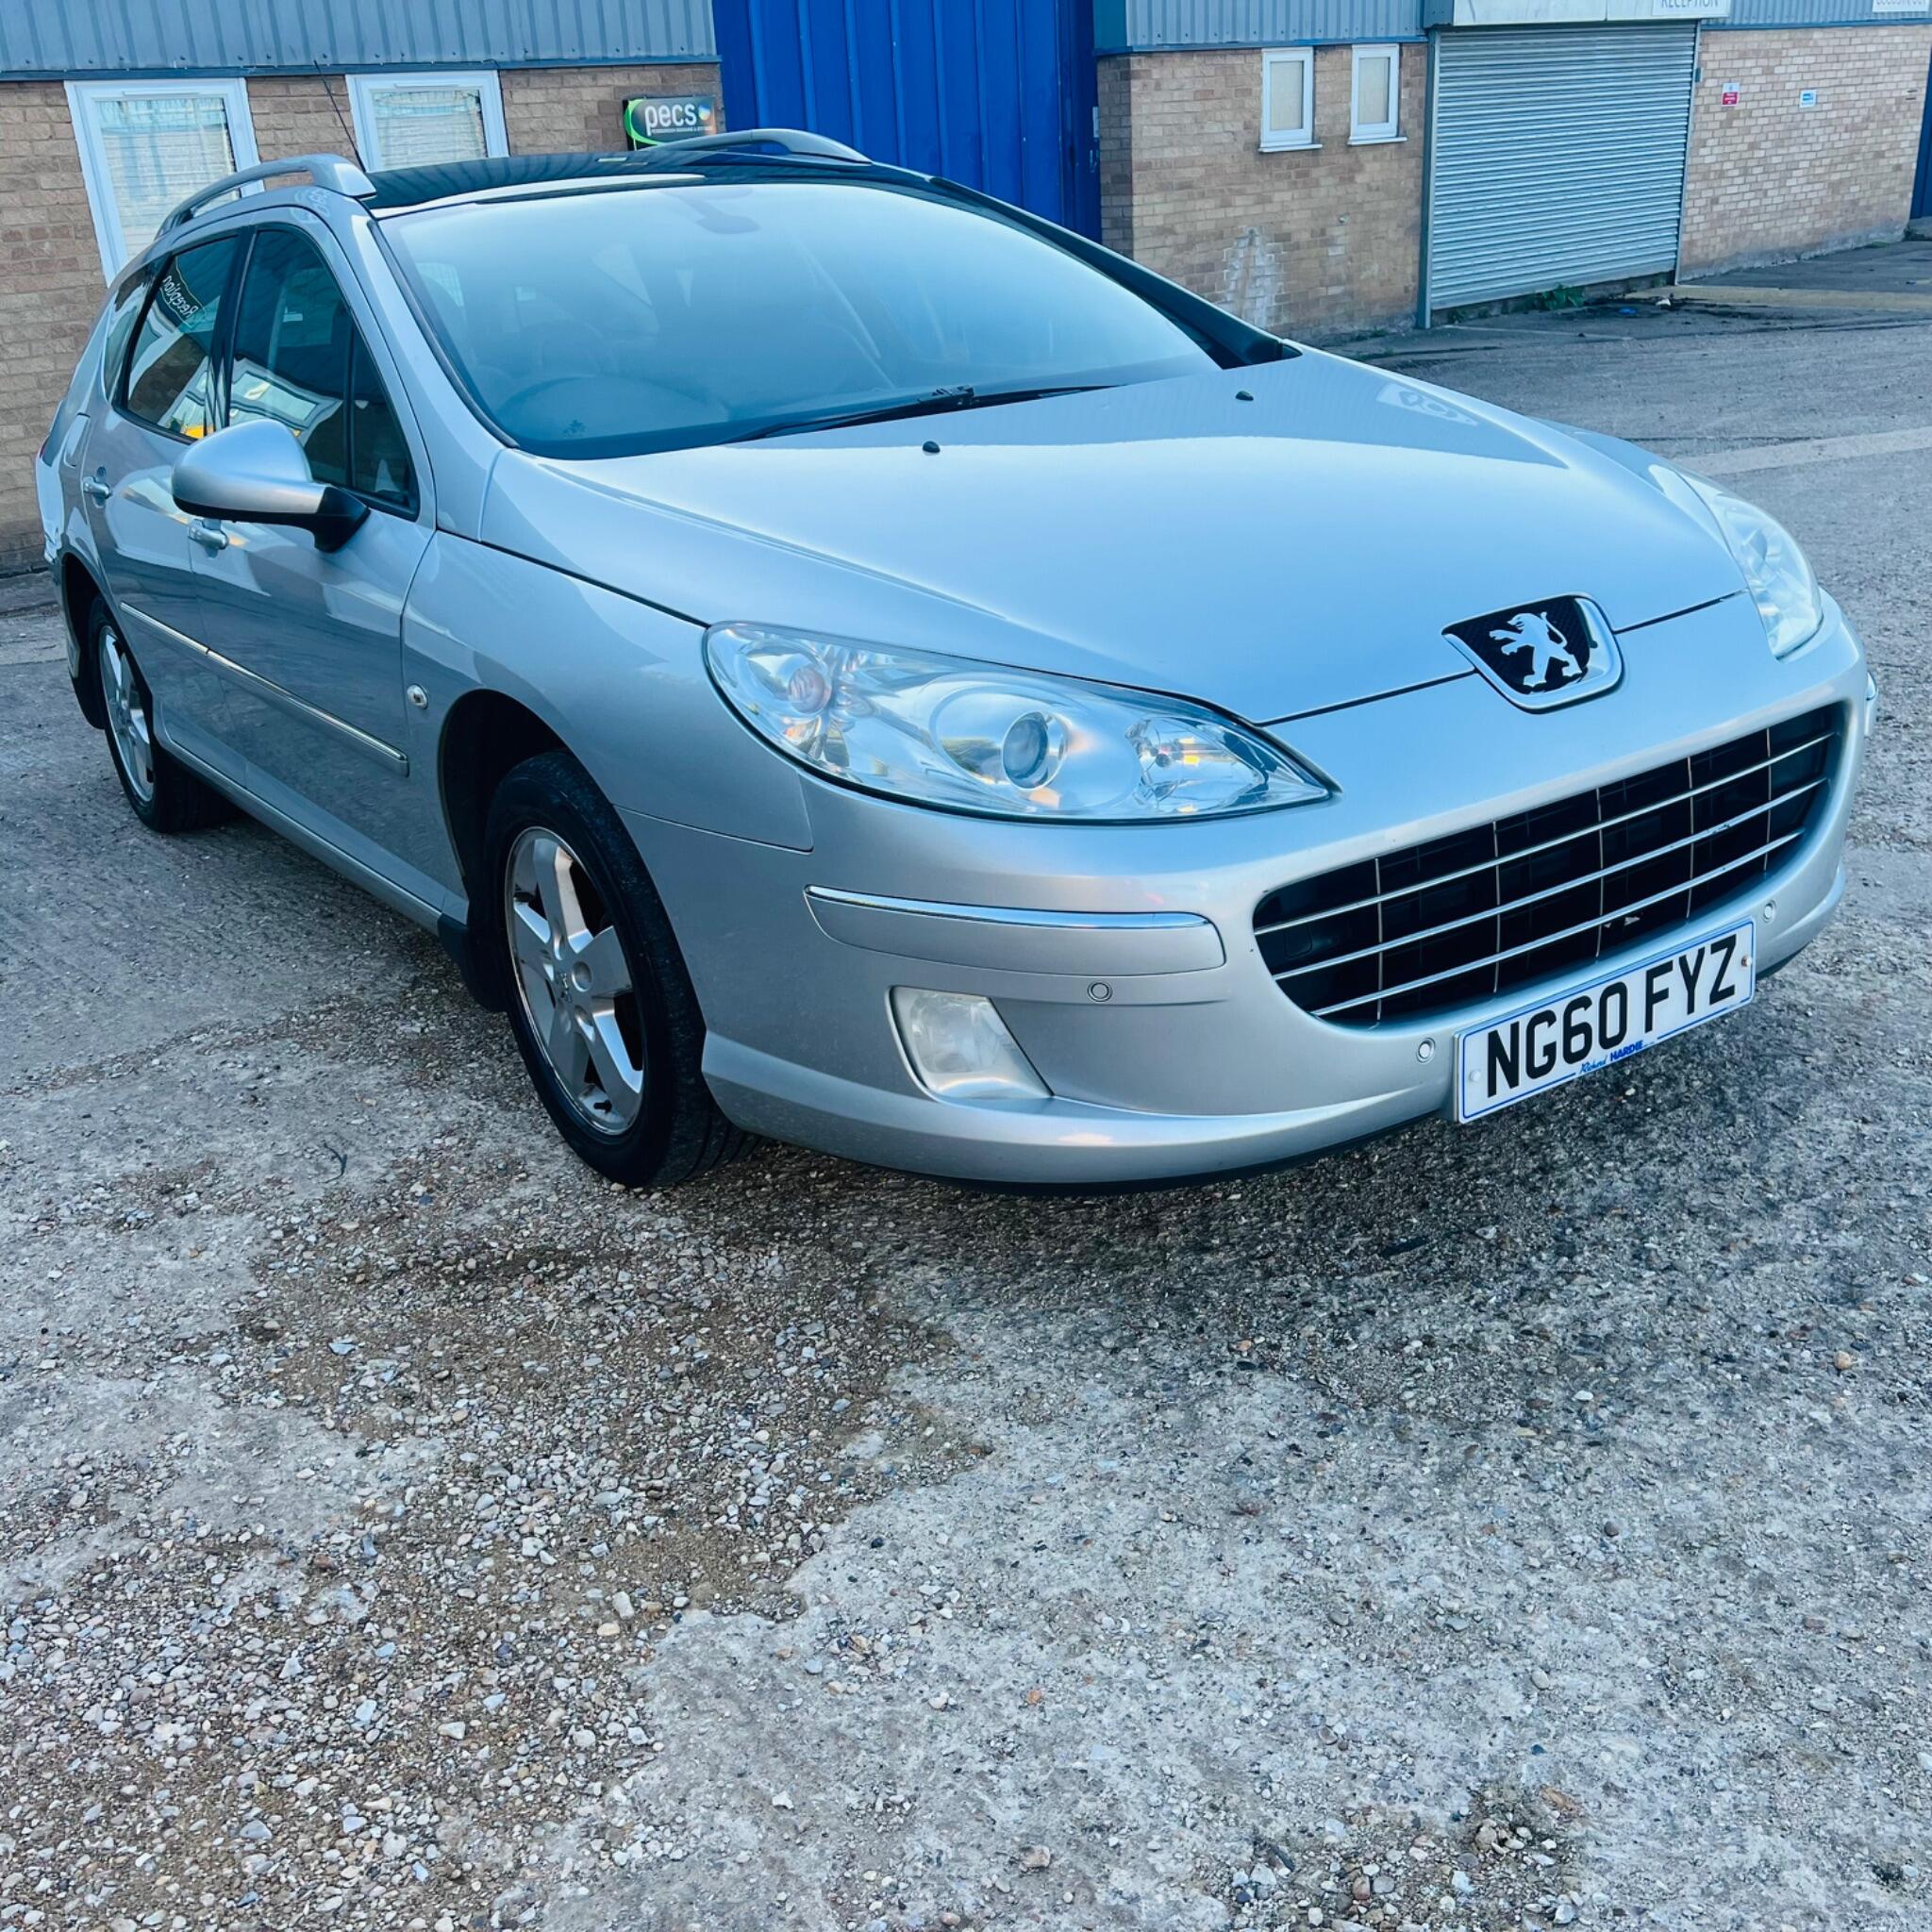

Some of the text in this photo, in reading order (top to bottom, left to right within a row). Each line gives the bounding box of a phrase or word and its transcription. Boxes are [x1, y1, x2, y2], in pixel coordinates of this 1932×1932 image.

[644, 104, 697, 137] pecs
[1487, 933, 1737, 1098] NG60 FYZ
[1609, 1040, 1643, 1061] HARDIE
